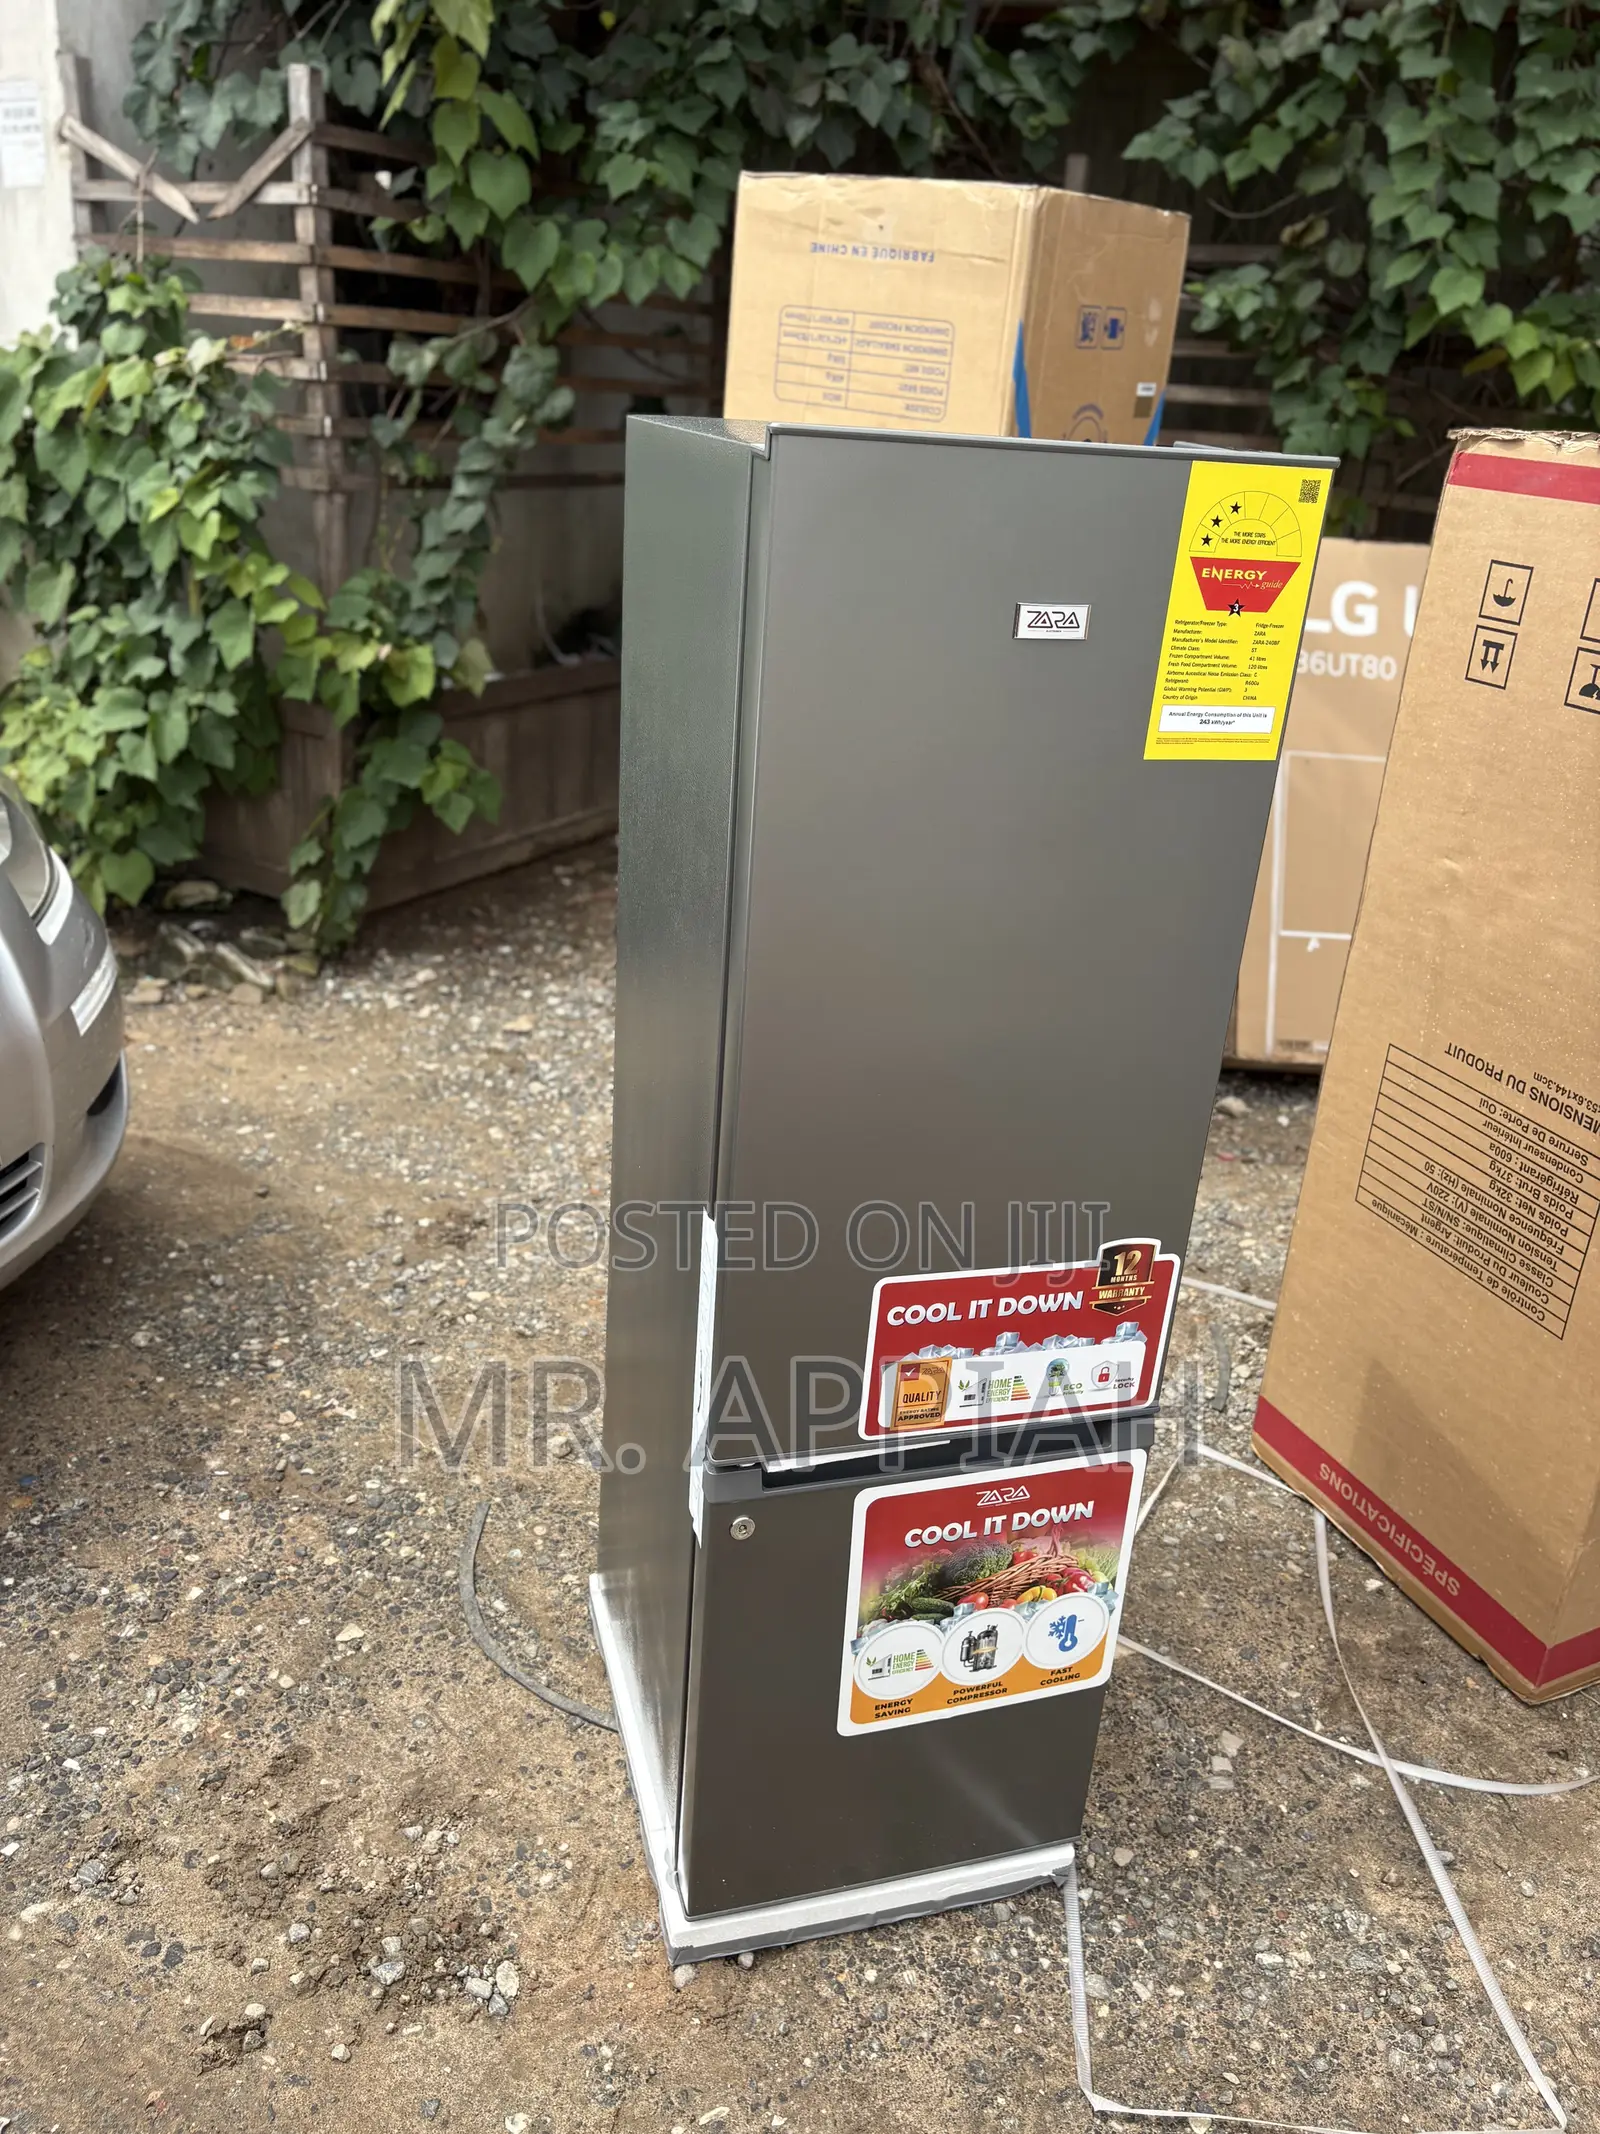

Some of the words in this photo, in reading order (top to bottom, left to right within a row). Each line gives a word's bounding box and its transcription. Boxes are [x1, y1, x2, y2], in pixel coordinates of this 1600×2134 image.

[811, 242, 848, 255] CHINE
[852, 245, 868, 257] EN
[1201, 566, 1267, 582] ENERGY
[1260, 580, 1283, 590] guide
[1233, 603, 1239, 612] 3
[1444, 1042, 1504, 1082] PRODUIT
[1505, 1074, 1527, 1095] DU
[1479, 1097, 1497, 1115] Oui
[1499, 1108, 1530, 1134] Porte:
[1482, 1119, 1524, 1150] Intérieur
[1531, 1127, 1547, 1143] De
[1489, 1142, 1513, 1163] 600a
[1548, 1137, 1589, 1167] Serrure
[1424, 1161, 1436, 1173] 50
[1488, 1160, 1513, 1178] 37kg
[1525, 1147, 1584, 1184] Condenseur
[1437, 1167, 1460, 1189] (Hz):
[1488, 1178, 1513, 1198] 32kg
[1513, 1175, 1541, 1199] Brut:
[1522, 1160, 1580, 1205] Réfrigérant
[1426, 1182, 1450, 1202] 220V
[1461, 1185, 1507, 1219] Nominale
[1421, 1197, 1460, 1227] SN/N/ST
[1449, 1195, 1469, 1214] (V):
[1513, 1196, 1537, 1216] Net:
[1542, 1193, 1575, 1220] Poids
[1371, 1198, 1419, 1237] Mécanique
[1420, 1213, 1452, 1239] Argent
[1469, 1208, 1516, 1247] Nominale
[1538, 1212, 1569, 1238] Poids
[1461, 1222, 1517, 1263] Climatique:
[1509, 1215, 1565, 1256] Fréquence
[1425, 1235, 1484, 1282] Température
[1452, 1235, 1490, 1266] Produit:
[1517, 1240, 1558, 1272] Tension
[1113, 1250, 1142, 1276] 12
[1492, 1260, 1507, 1277] Du
[1519, 1258, 1554, 1288] Classe
[1110, 1274, 1138, 1284] MONTHS
[1486, 1276, 1500, 1290] de
[1098, 1286, 1146, 1300] WARRANTY
[1508, 1274, 1550, 1305] Couleur
[887, 1304, 963, 1327] COOL
[968, 1298, 995, 1321] IT
[997, 1291, 1084, 1319] DOWN
[1501, 1287, 1546, 1322] Contrôle
[986, 1388, 1012, 1397] ENERGY
[987, 1378, 1013, 1390] HOME
[1063, 1382, 1083, 1391] ECO
[1113, 1381, 1136, 1390] LOCK
[902, 1390, 942, 1404] QUALITY
[897, 1411, 941, 1422] APPROVED
[904, 1520, 977, 1548] COOL
[983, 1514, 1009, 1537] IT
[1011, 1500, 1095, 1532] DOWN
[1319, 1463, 1461, 1597] SPÉCIFICATIONS
[892, 1660, 915, 1670] ENERGY
[893, 1651, 916, 1663] HOME
[1039, 1673, 1081, 1687] COOLING
[1049, 1666, 1074, 1677] FAST
[946, 1687, 1008, 1705] COMPRESSOR
[952, 1681, 1004, 1696] POWERFUL
[873, 1698, 914, 1711] ENERGY
[873, 1706, 912, 1719] SAVING
